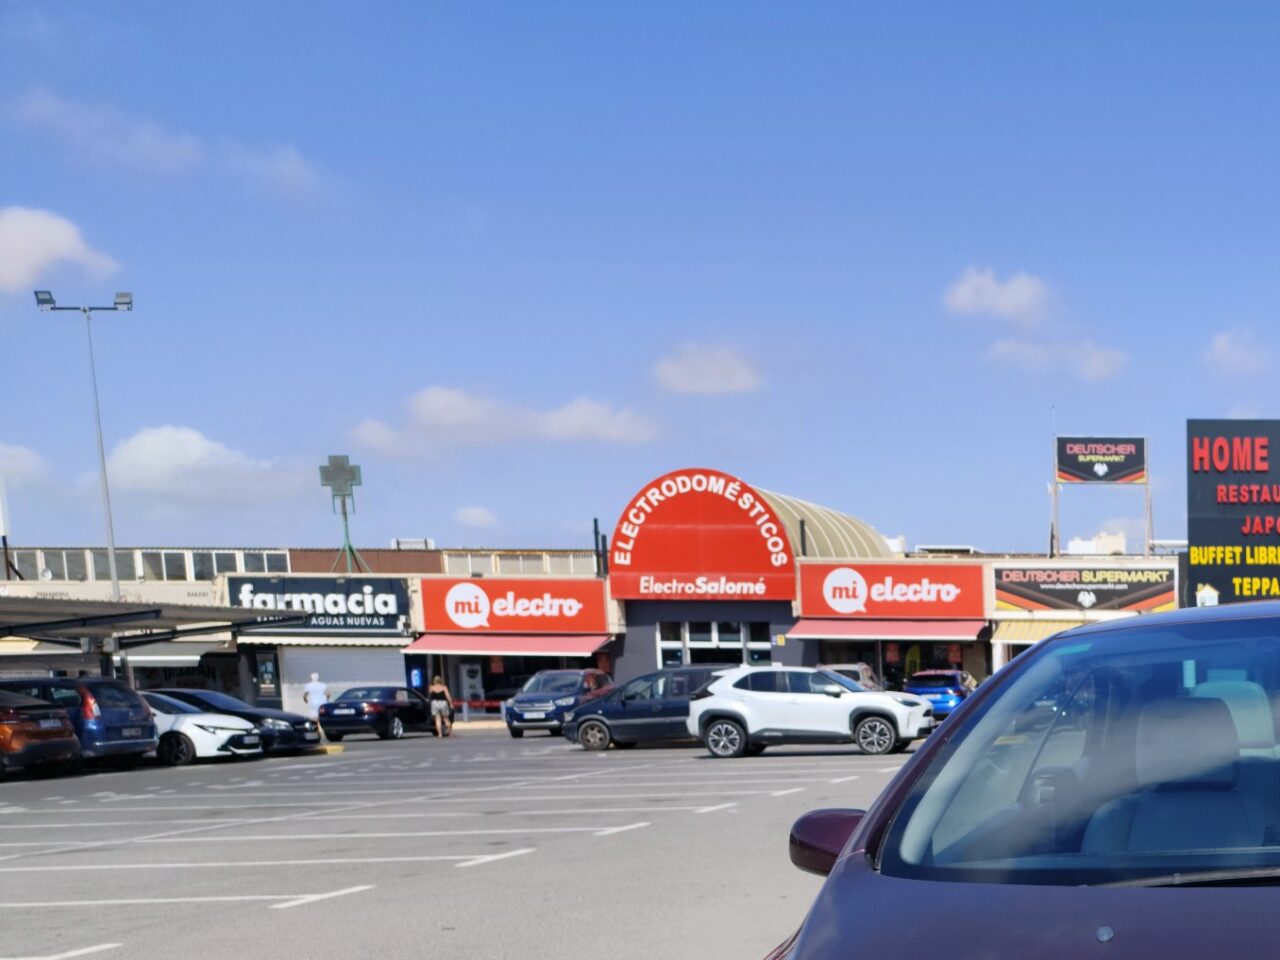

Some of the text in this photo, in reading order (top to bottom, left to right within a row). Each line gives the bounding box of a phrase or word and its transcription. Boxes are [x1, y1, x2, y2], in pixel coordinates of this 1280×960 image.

[1066, 444, 1136, 454] DEUTSCHER
[1193, 437, 1269, 472] HOME
[614, 474, 787, 567] ELECTRODOMÉSTICOS
[1190, 546, 1242, 565] BUFFET
[640, 576, 766, 594] ElectroSalomé
[1002, 571, 1169, 582] DEUTSCHER SUPERMARKT
[239, 584, 398, 615] farmacia
[832, 576, 961, 602] mi electro
[455, 591, 583, 617] mi electro
[311, 617, 384, 625] AGUAS NUEVAS
